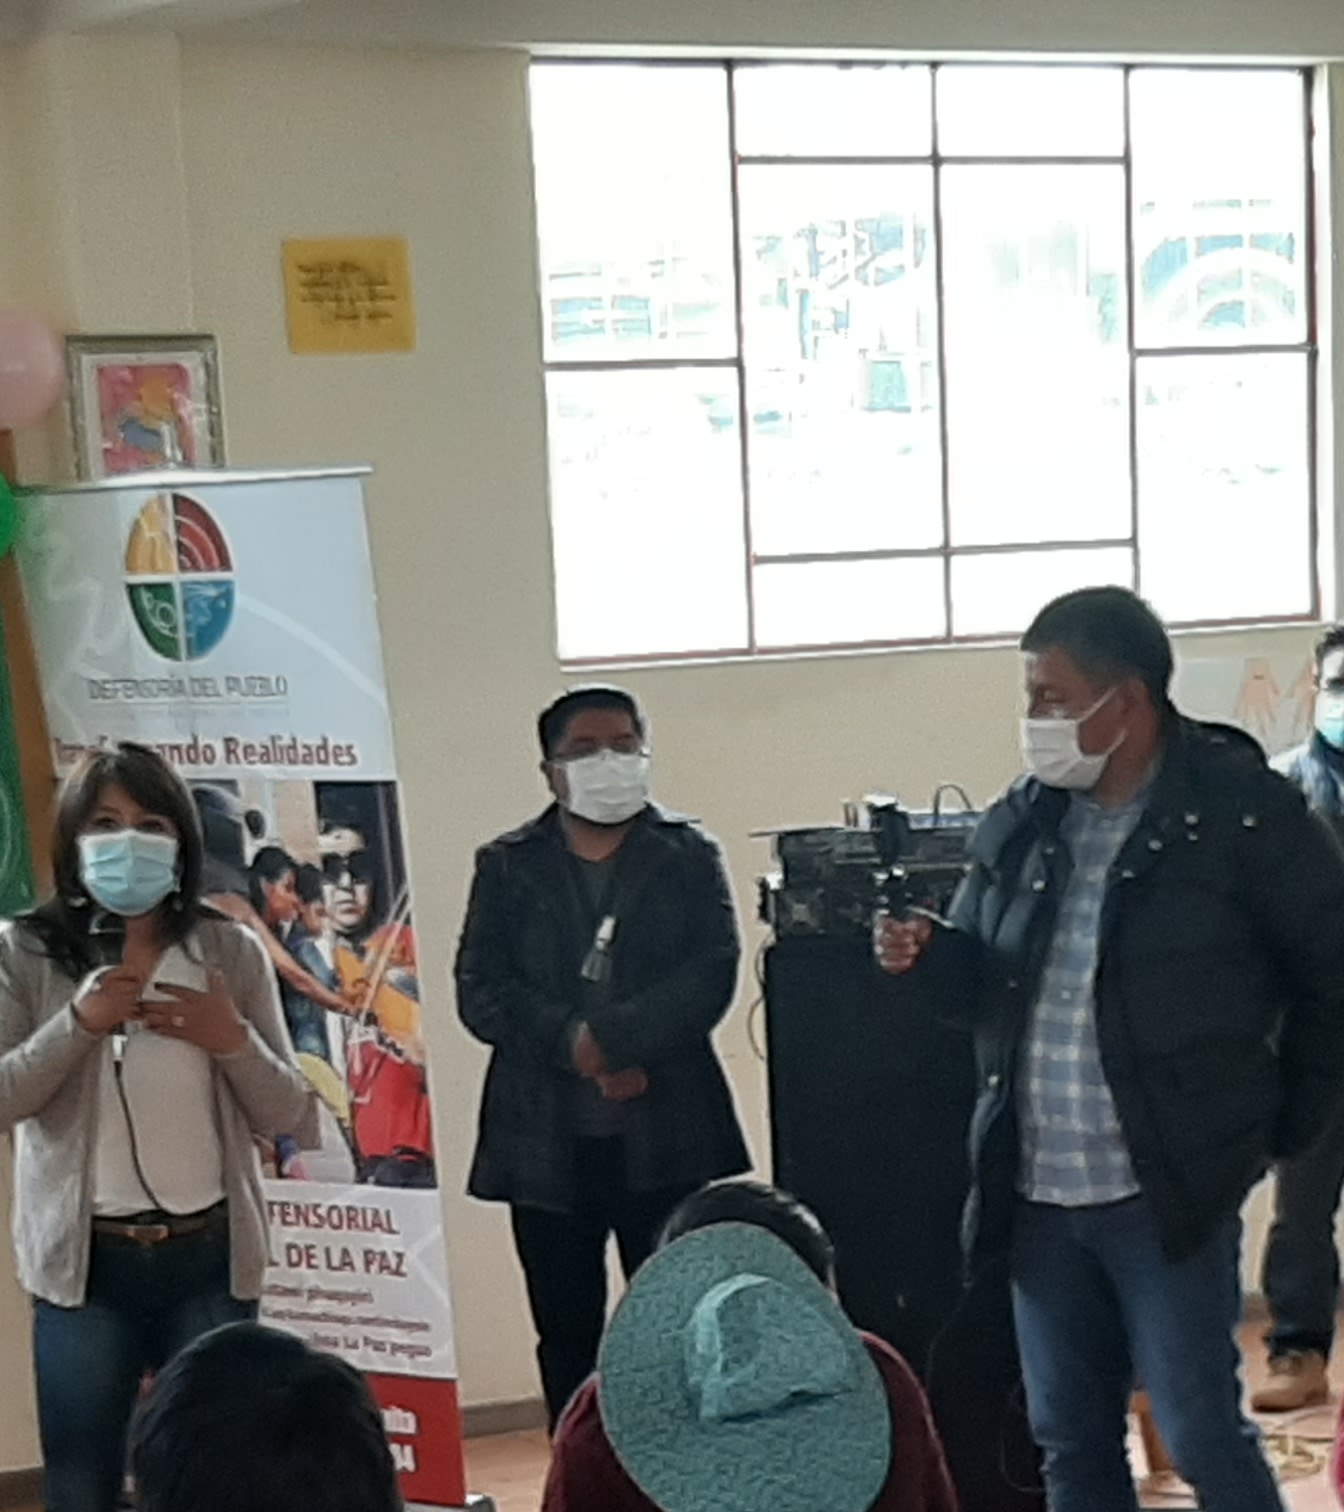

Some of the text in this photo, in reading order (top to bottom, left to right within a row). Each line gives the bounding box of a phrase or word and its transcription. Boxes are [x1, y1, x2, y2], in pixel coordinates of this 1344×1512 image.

[189, 676, 221, 698] DEL
[225, 674, 289, 698] PUEBLO
[224, 735, 359, 767] Realidades
[286, 1242, 319, 1269] DE
[324, 1246, 356, 1272] LA
[364, 1249, 408, 1277] PAZ
